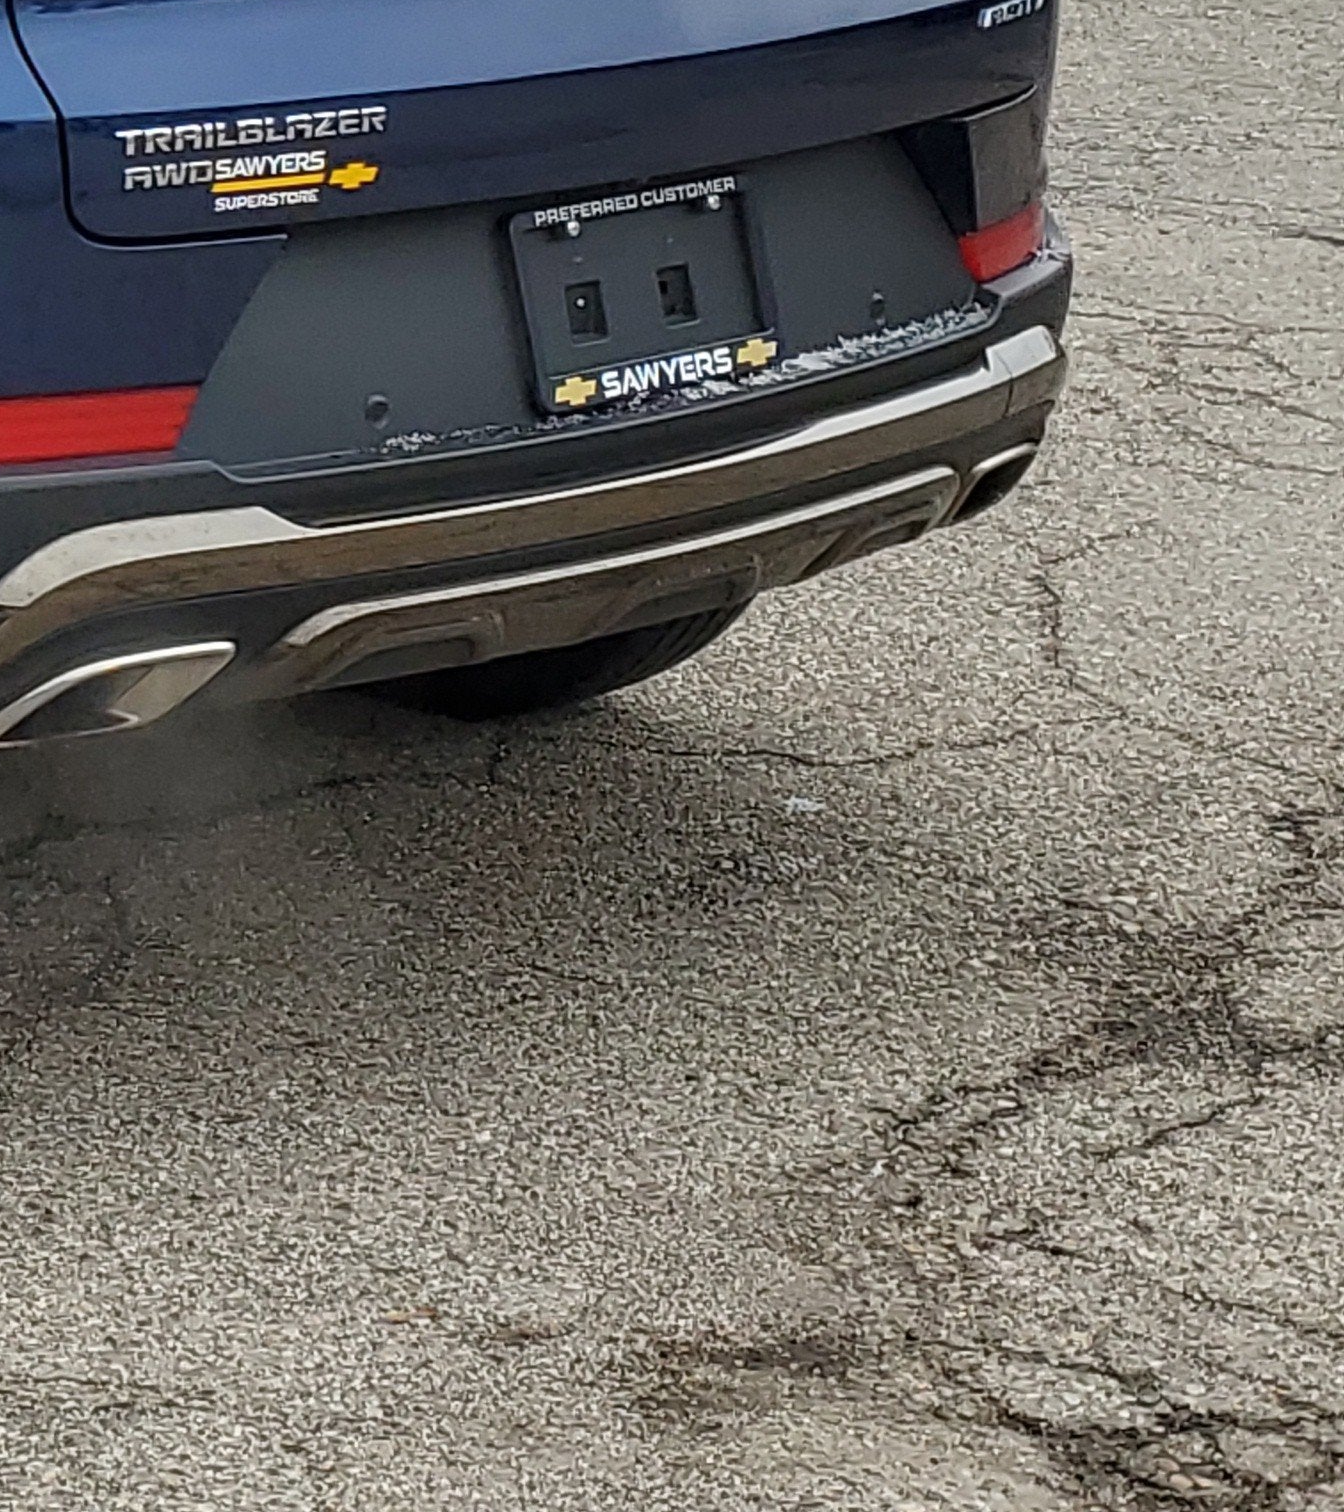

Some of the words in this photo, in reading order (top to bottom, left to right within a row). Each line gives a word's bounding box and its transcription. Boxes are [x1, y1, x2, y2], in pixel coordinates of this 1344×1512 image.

[115, 106, 387, 156] TRAILBLAZER
[124, 160, 212, 190] AWD
[215, 150, 326, 180] SAWYERS
[214, 189, 320, 212] SUPERSTORE
[534, 193, 639, 227] PREFERRED
[640, 176, 736, 207] CUSTOMER
[601, 347, 733, 398] SAWYERS
